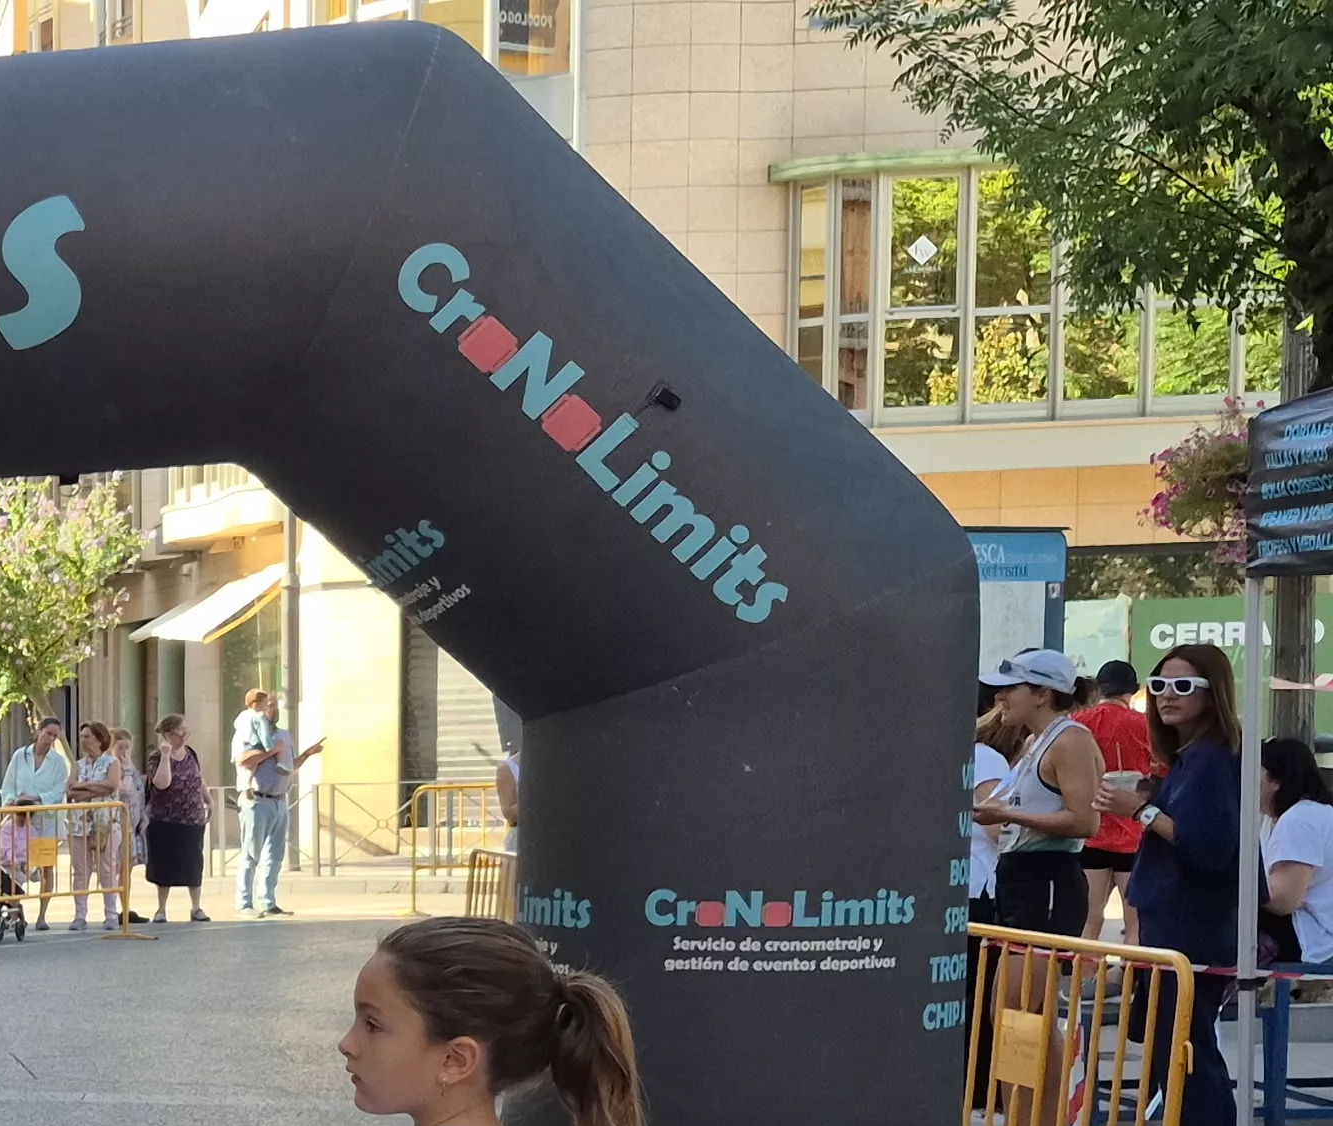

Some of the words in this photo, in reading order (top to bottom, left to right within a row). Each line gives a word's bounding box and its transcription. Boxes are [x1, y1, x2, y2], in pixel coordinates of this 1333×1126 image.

[1287, 473, 1333, 498] CORREDO
[672, 936, 735, 952] Servicio
[739, 937, 761, 952] de
[764, 936, 870, 952] cronometraje
[873, 937, 883, 951] y
[663, 957, 724, 972] gestión
[727, 957, 749, 971] de
[752, 957, 816, 972] eventos
[819, 955, 896, 972] deportivos
